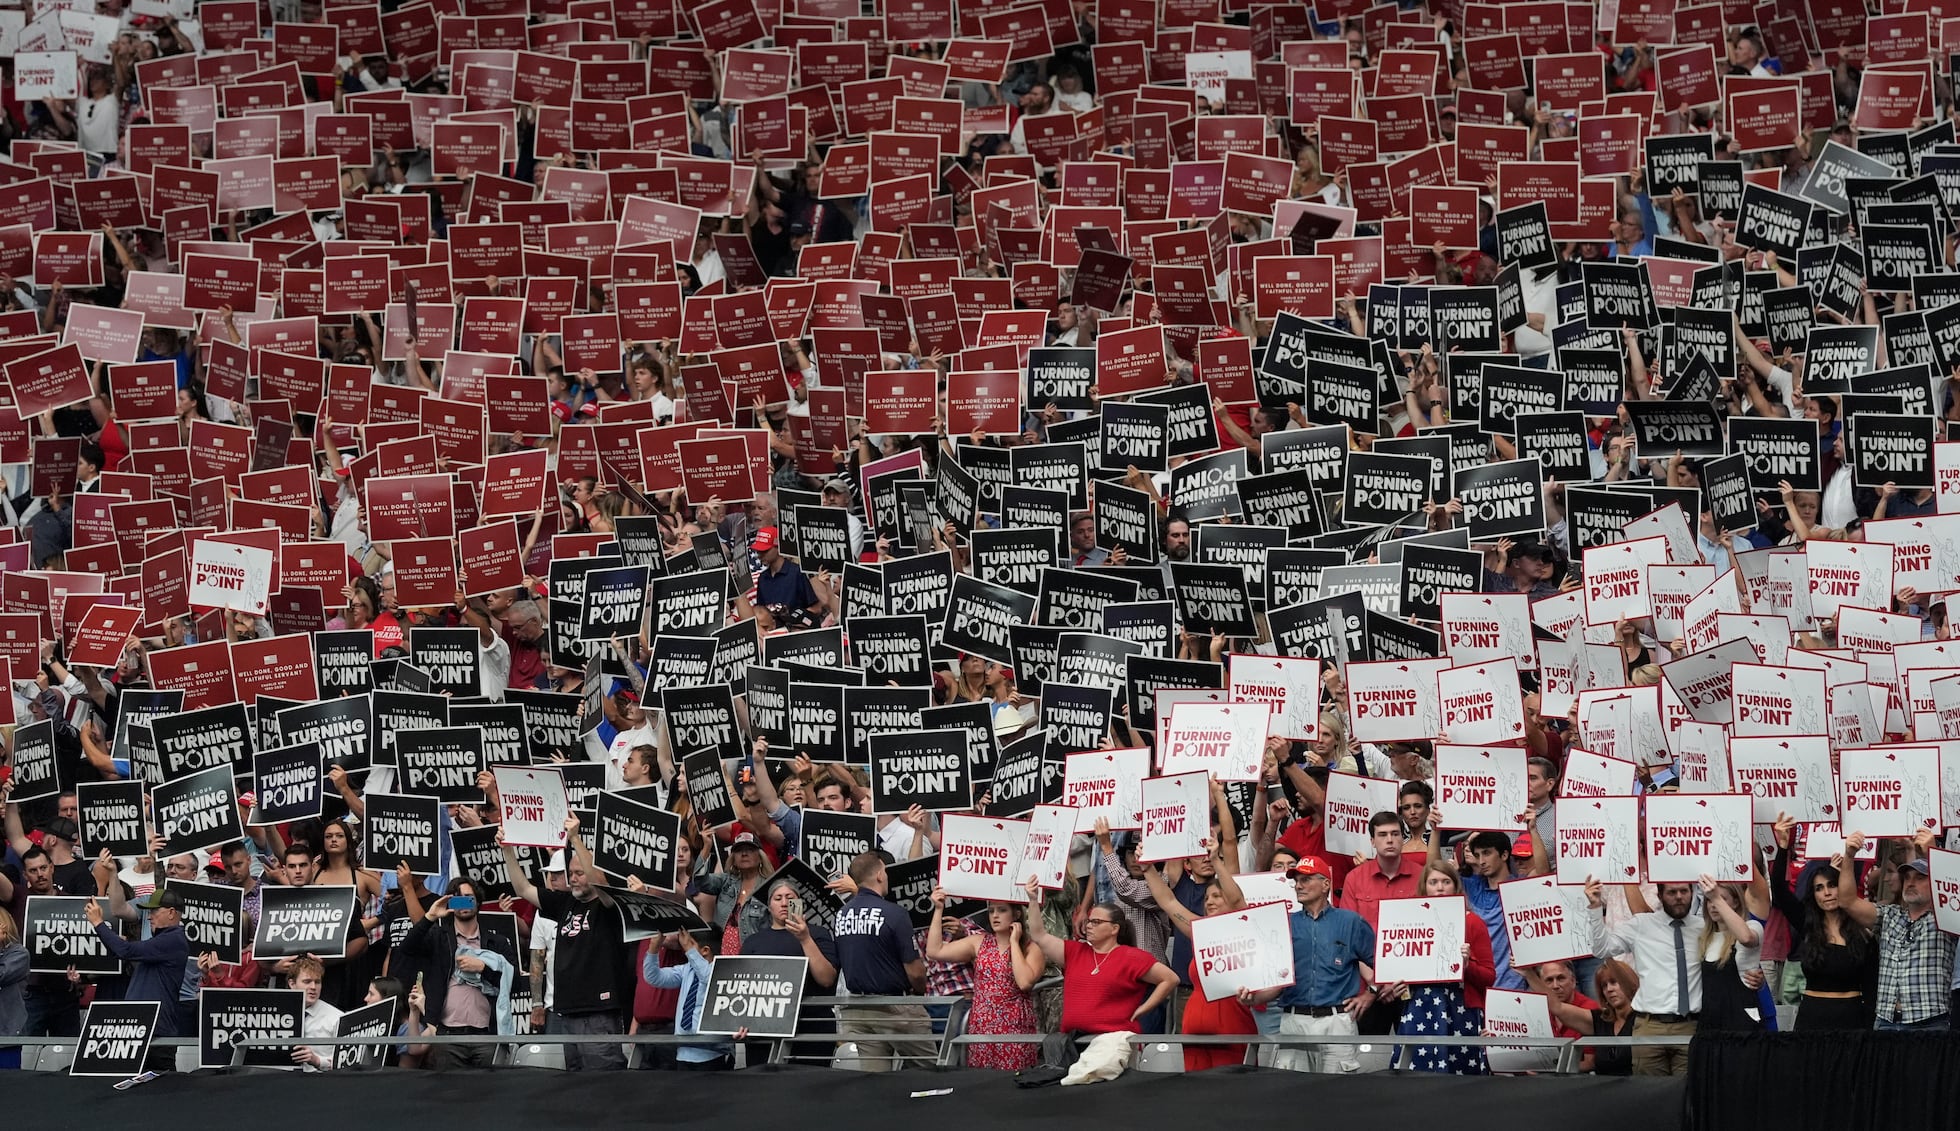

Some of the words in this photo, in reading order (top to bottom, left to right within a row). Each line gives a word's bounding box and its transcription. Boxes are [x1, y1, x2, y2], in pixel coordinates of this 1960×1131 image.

[19, 75, 55, 86] POINT
[1746, 203, 1801, 230] TURNING
[1743, 222, 1800, 247] POINT
[1033, 366, 1090, 380] TURNING
[1033, 380, 1090, 397] POINT
[1312, 380, 1372, 401] TURNING
[1314, 395, 1371, 420] POINT
[1105, 423, 1161, 439] TURNING
[1106, 437, 1161, 458] POINT
[1736, 439, 1810, 455] TURNING
[1860, 437, 1927, 451] TURNING
[1863, 453, 1927, 472] POINT
[1353, 474, 1423, 492] TURNING
[1460, 481, 1534, 501] TURNING
[1354, 490, 1422, 511] POINT
[1463, 499, 1535, 523] POINT
[801, 526, 846, 542] TURNING
[803, 541, 847, 560] POINT
[196, 563, 245, 577] TURNING
[1588, 569, 1639, 585] TURNING
[1808, 568, 1860, 581] TURNING
[196, 575, 244, 591] POINT
[1591, 582, 1639, 601] POINT
[1809, 581, 1860, 597] POINT
[658, 591, 719, 612] TURNING
[658, 607, 719, 632] POINT
[1447, 621, 1499, 632] TURNING
[855, 638, 920, 654] TURNING
[1451, 634, 1500, 648] POINT
[860, 653, 922, 673] POINT
[749, 692, 785, 708] TURNING
[1353, 689, 1417, 702] TURNING
[1444, 691, 1493, 710] TURNING
[1737, 694, 1792, 708] TURNING
[671, 708, 728, 726] TURNING
[1046, 707, 1103, 725] TURNING
[1357, 701, 1417, 719] POINT
[1446, 704, 1494, 726] POINT
[1740, 707, 1792, 725] POINT
[750, 708, 785, 731] POINT
[163, 727, 241, 752] TURNING
[288, 718, 365, 744] TURNING
[676, 725, 732, 746] POINT
[1047, 724, 1101, 748] POINT
[1173, 731, 1232, 742] TURNING
[170, 742, 244, 772] POINT
[1172, 742, 1230, 757] POINT
[404, 751, 476, 767] TURNING
[879, 753, 960, 773] TURNING
[260, 766, 316, 788] TURNING
[409, 767, 478, 789] POINT
[882, 771, 960, 796] POINT
[1441, 775, 1496, 787] TURNING
[1737, 769, 1797, 780] TURNING
[1068, 780, 1116, 793] TURNING
[1741, 782, 1797, 798] POINT
[1844, 781, 1901, 792] TURNING
[160, 789, 228, 821] TURNING
[262, 782, 316, 810] POINT
[502, 794, 543, 806] TURNING
[1069, 791, 1115, 808] POINT
[1442, 787, 1496, 805] POINT
[1847, 794, 1901, 811] POINT
[83, 805, 138, 820] TURNING
[505, 805, 545, 822] POINT
[1146, 804, 1186, 820] TURNING
[1328, 801, 1369, 818] TURNING
[163, 804, 230, 840] POINT
[371, 817, 432, 834] TURNING
[1146, 818, 1185, 837] POINT
[1328, 814, 1370, 834] POINT
[86, 821, 139, 842] POINT
[602, 818, 669, 851] TURNING
[1559, 828, 1605, 840] TURNING
[1651, 826, 1712, 838] TURNING
[372, 834, 432, 857] POINT
[602, 835, 668, 872] POINT
[946, 843, 1008, 858] TURNING
[1561, 841, 1605, 858] POINT
[1654, 839, 1712, 856] POINT
[947, 857, 1007, 876] POINT
[268, 908, 343, 924] TURNING
[836, 907, 884, 921] S.A.F.E.
[1508, 905, 1562, 925] TURNING
[265, 922, 340, 942] POINT
[834, 917, 885, 936] SECURITY
[1381, 928, 1434, 940] TURNING
[1512, 919, 1563, 941] POINT
[1199, 938, 1256, 957] TURNING
[1382, 940, 1434, 957] POINT
[1203, 951, 1256, 977] POINT
[717, 980, 793, 995] TURNING
[713, 996, 791, 1018] POINT
[210, 1013, 294, 1028] TURNING
[88, 1025, 146, 1038] TURNING
[83, 1040, 143, 1060] POINT
